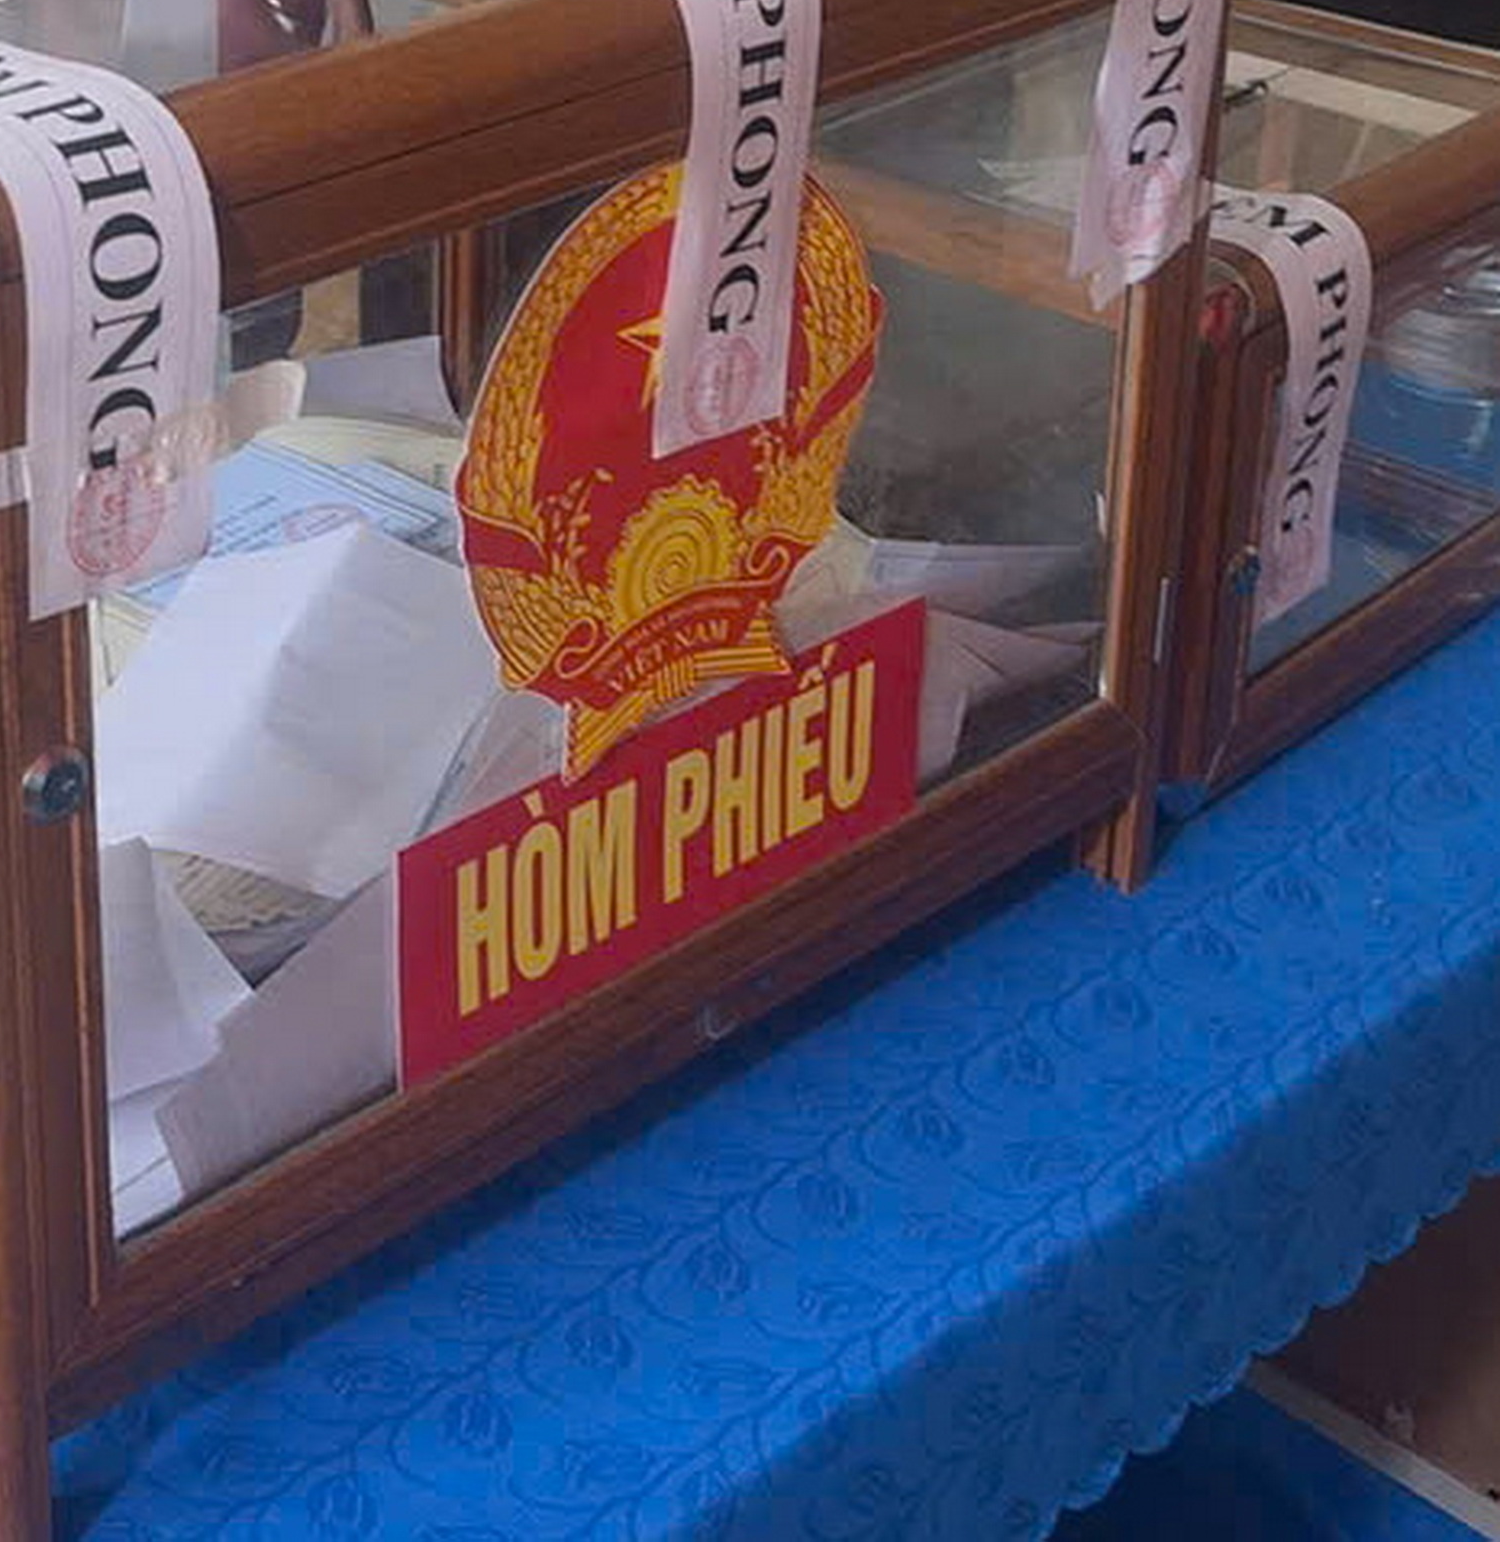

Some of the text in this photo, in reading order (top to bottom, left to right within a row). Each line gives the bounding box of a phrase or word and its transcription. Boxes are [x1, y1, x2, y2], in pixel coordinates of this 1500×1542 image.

[12, 91, 164, 472] PHONG
[1280, 267, 1350, 534] PHONG
[456, 643, 877, 1018] HÒM PHIẾU
